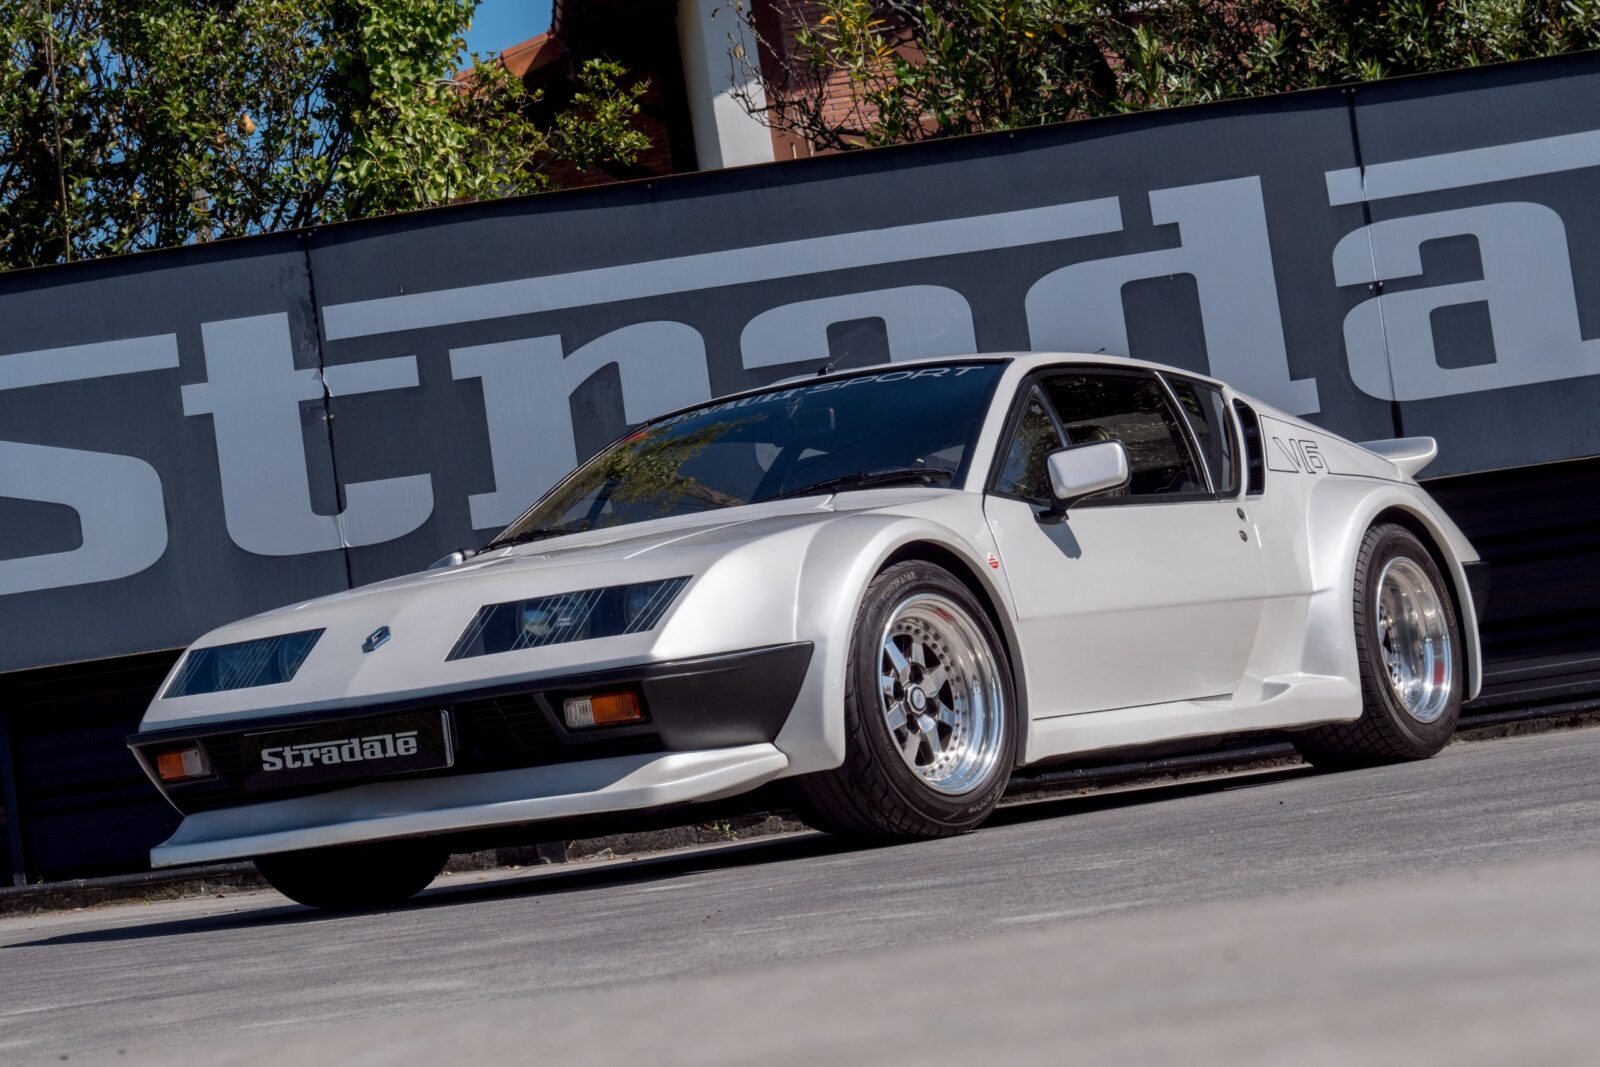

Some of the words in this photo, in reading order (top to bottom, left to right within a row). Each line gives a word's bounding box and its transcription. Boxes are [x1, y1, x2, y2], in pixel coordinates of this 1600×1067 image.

[806, 366, 985, 395] SPORT
[1272, 436, 1331, 475] V6
[260, 730, 418, 772] Stradale
